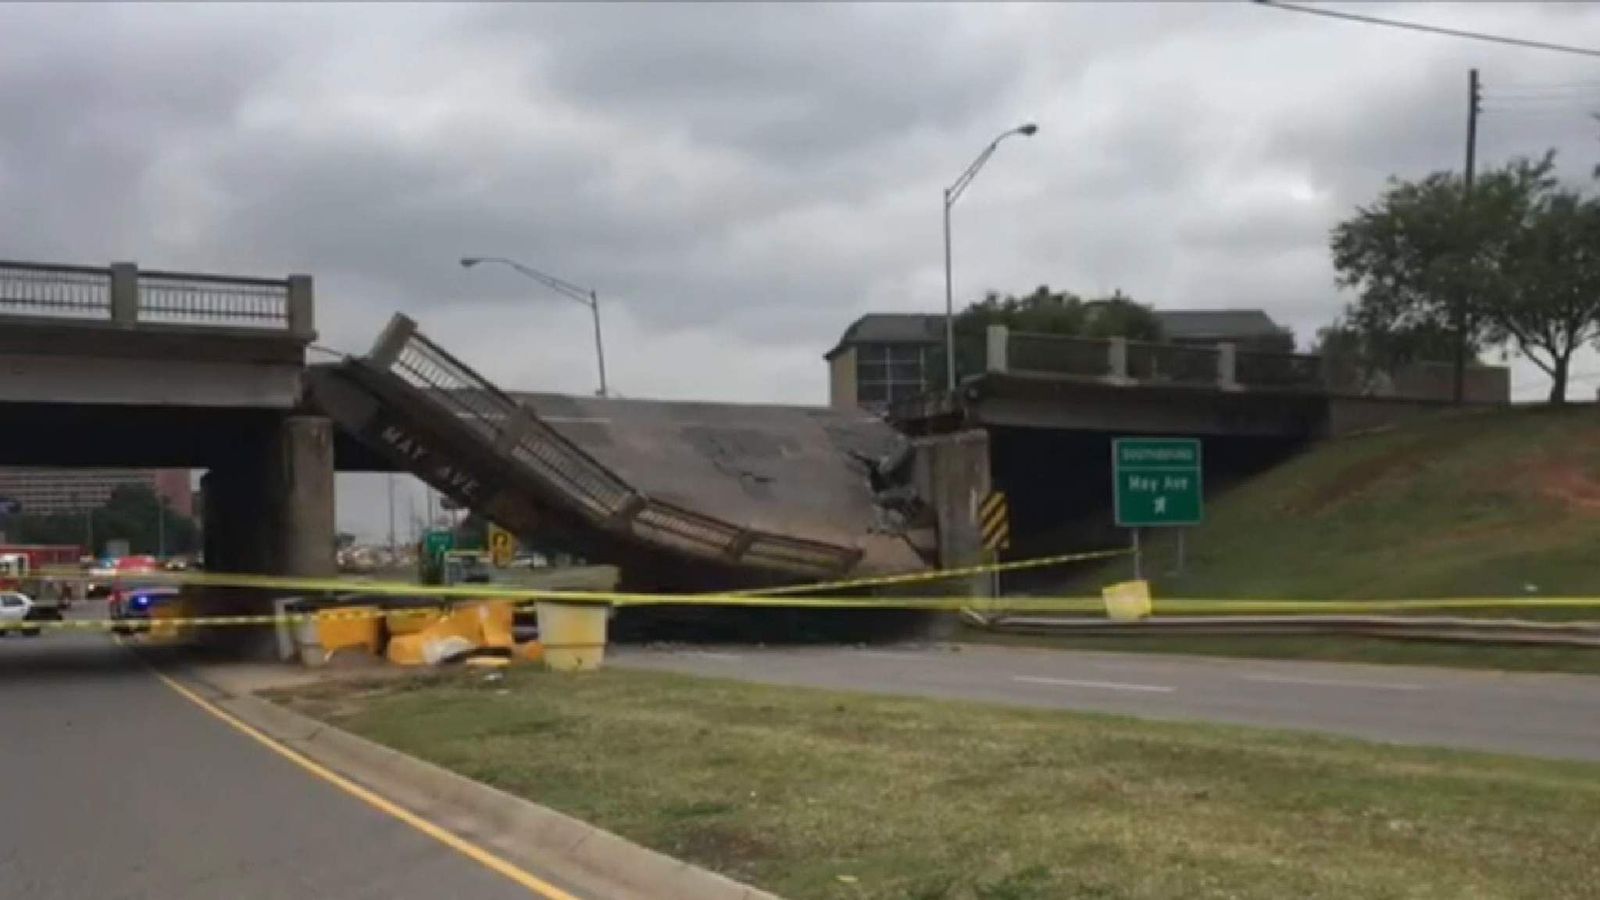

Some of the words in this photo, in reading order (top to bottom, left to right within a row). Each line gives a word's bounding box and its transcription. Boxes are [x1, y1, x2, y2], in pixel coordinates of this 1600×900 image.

[381, 426, 428, 459] MAY
[436, 466, 479, 497] AVE
[1128, 475, 1158, 494] May
[1164, 475, 1188, 491] Ave
